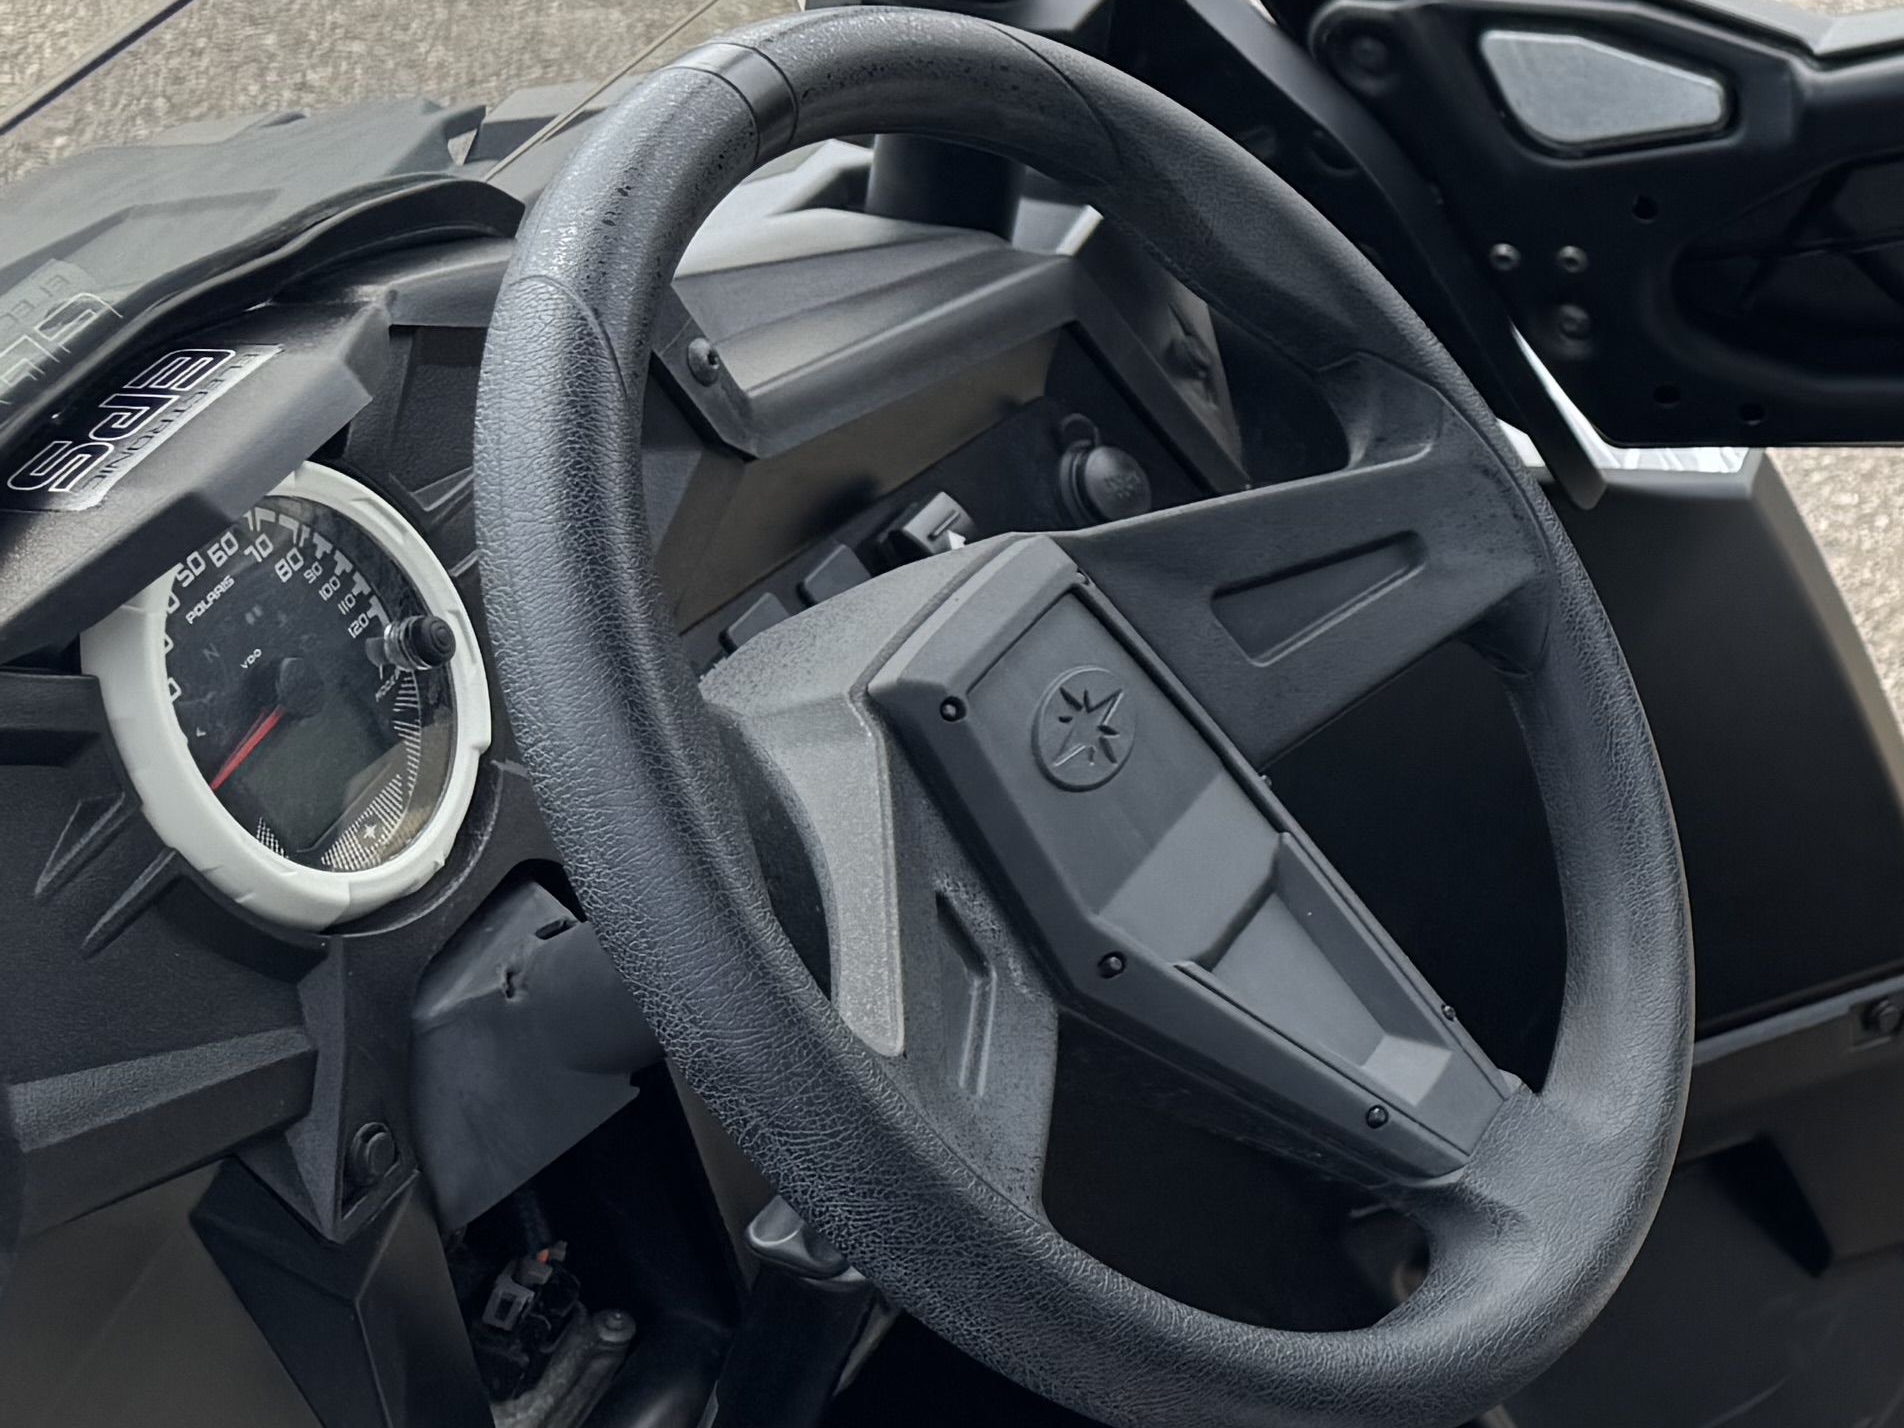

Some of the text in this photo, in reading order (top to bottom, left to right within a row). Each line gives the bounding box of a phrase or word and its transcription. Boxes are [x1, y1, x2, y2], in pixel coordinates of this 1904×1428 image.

[7, 348, 236, 492] EPS
[80, 352, 260, 490] ELECTRONIC
[207, 531, 239, 568] 60
[244, 533, 274, 563] 70
[176, 550, 206, 588] 50
[274, 547, 304, 582] 80
[303, 561, 323, 584] 90
[185, 574, 235, 624] POLARIS
[319, 576, 340, 601] 100
[337, 594, 356, 615] 110
[348, 613, 370, 638] 120
[240, 648, 262, 669] VDO
